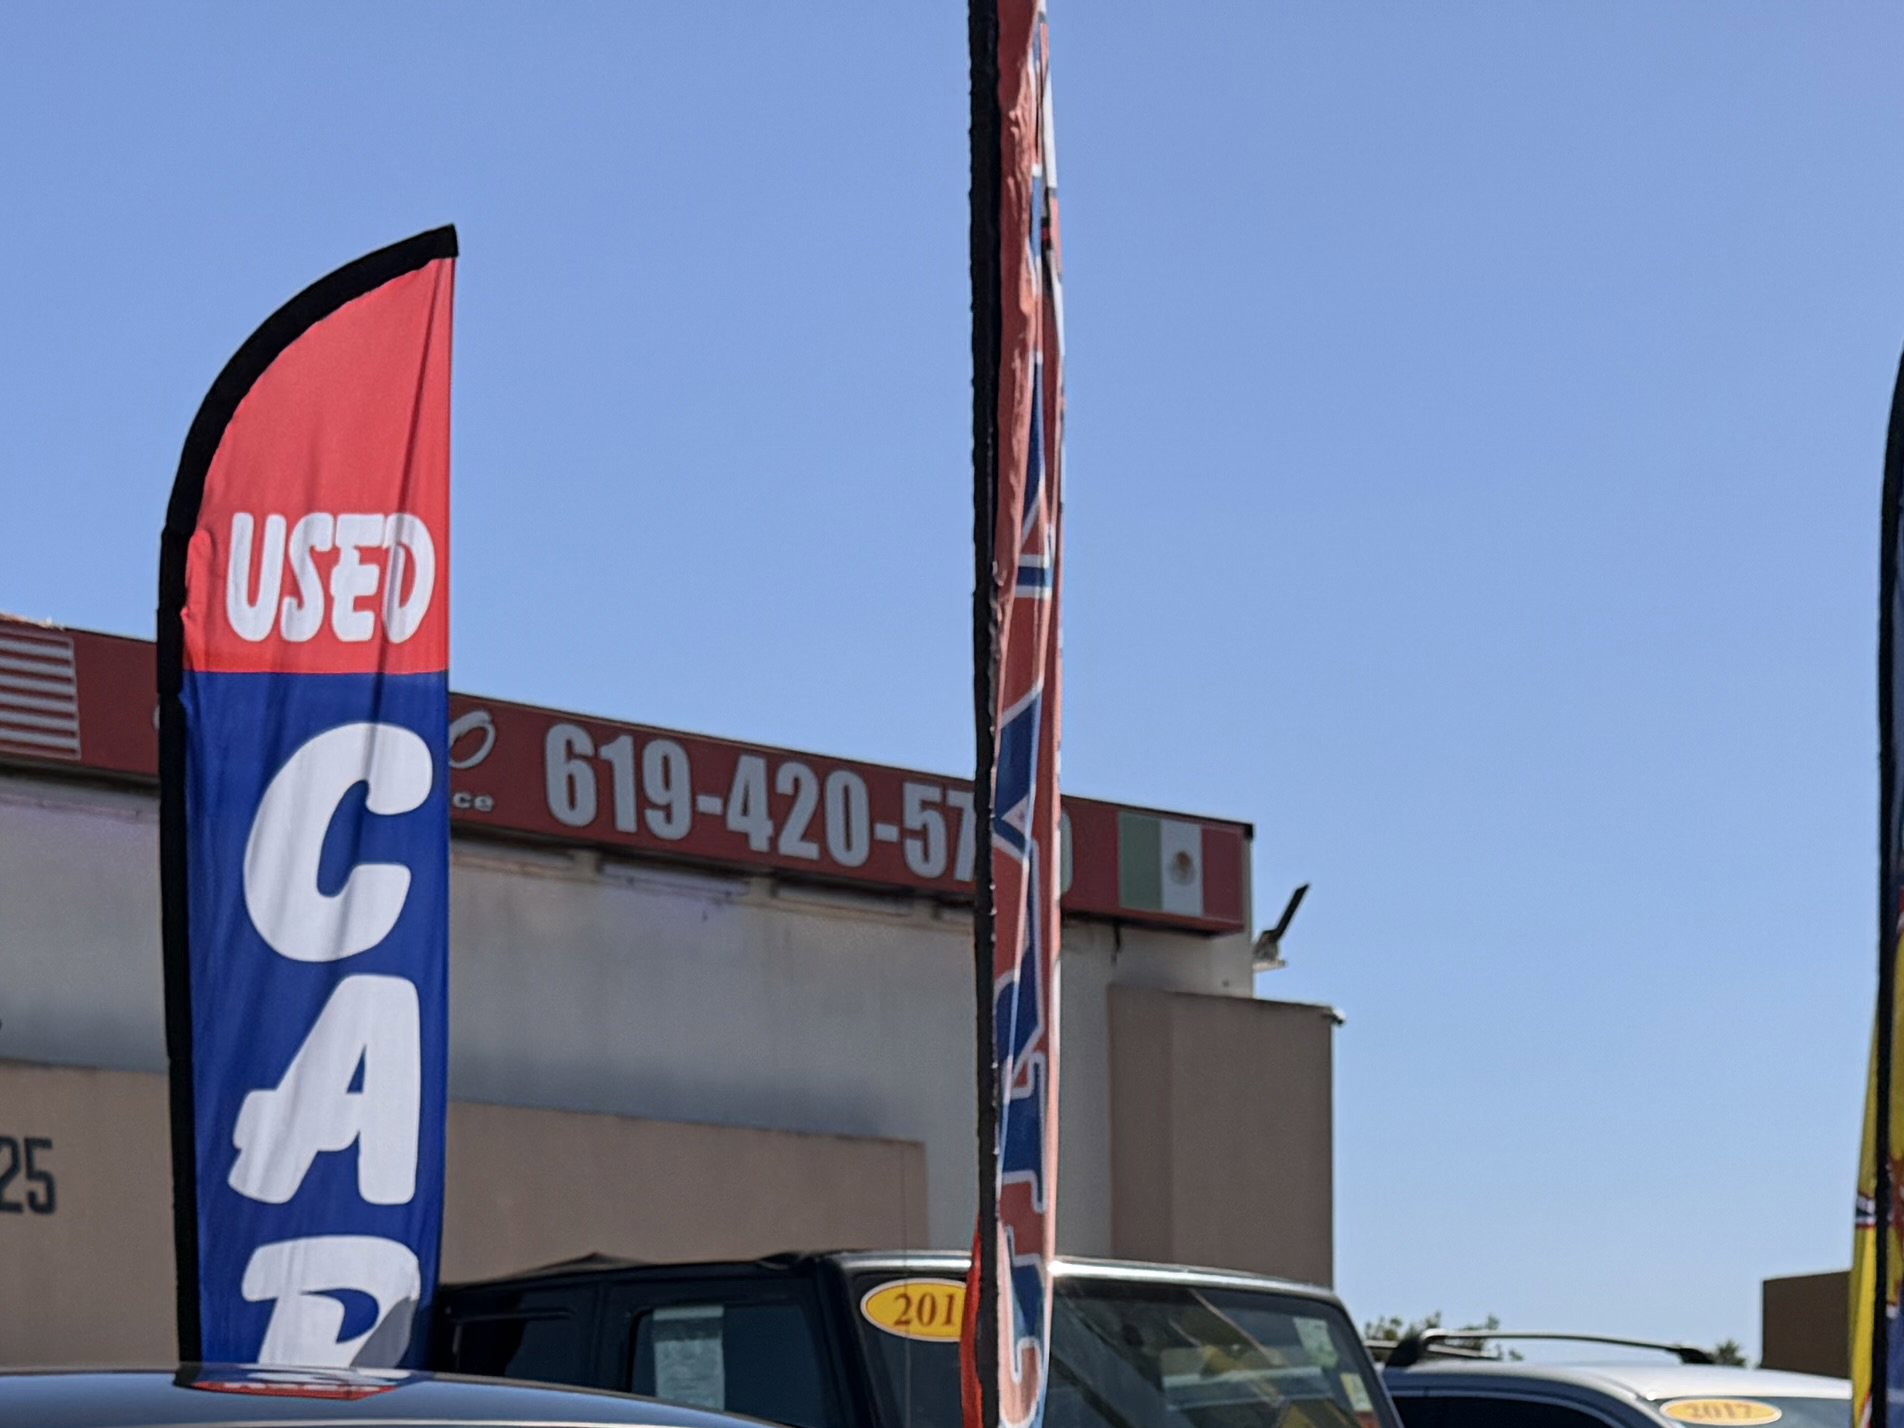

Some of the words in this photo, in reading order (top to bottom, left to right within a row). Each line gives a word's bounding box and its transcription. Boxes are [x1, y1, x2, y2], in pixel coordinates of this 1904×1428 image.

[226, 511, 436, 643] USED
[545, 722, 1072, 897] 619-420-57
[227, 722, 433, 1367] CAR
[893, 1291, 955, 1327] 201
